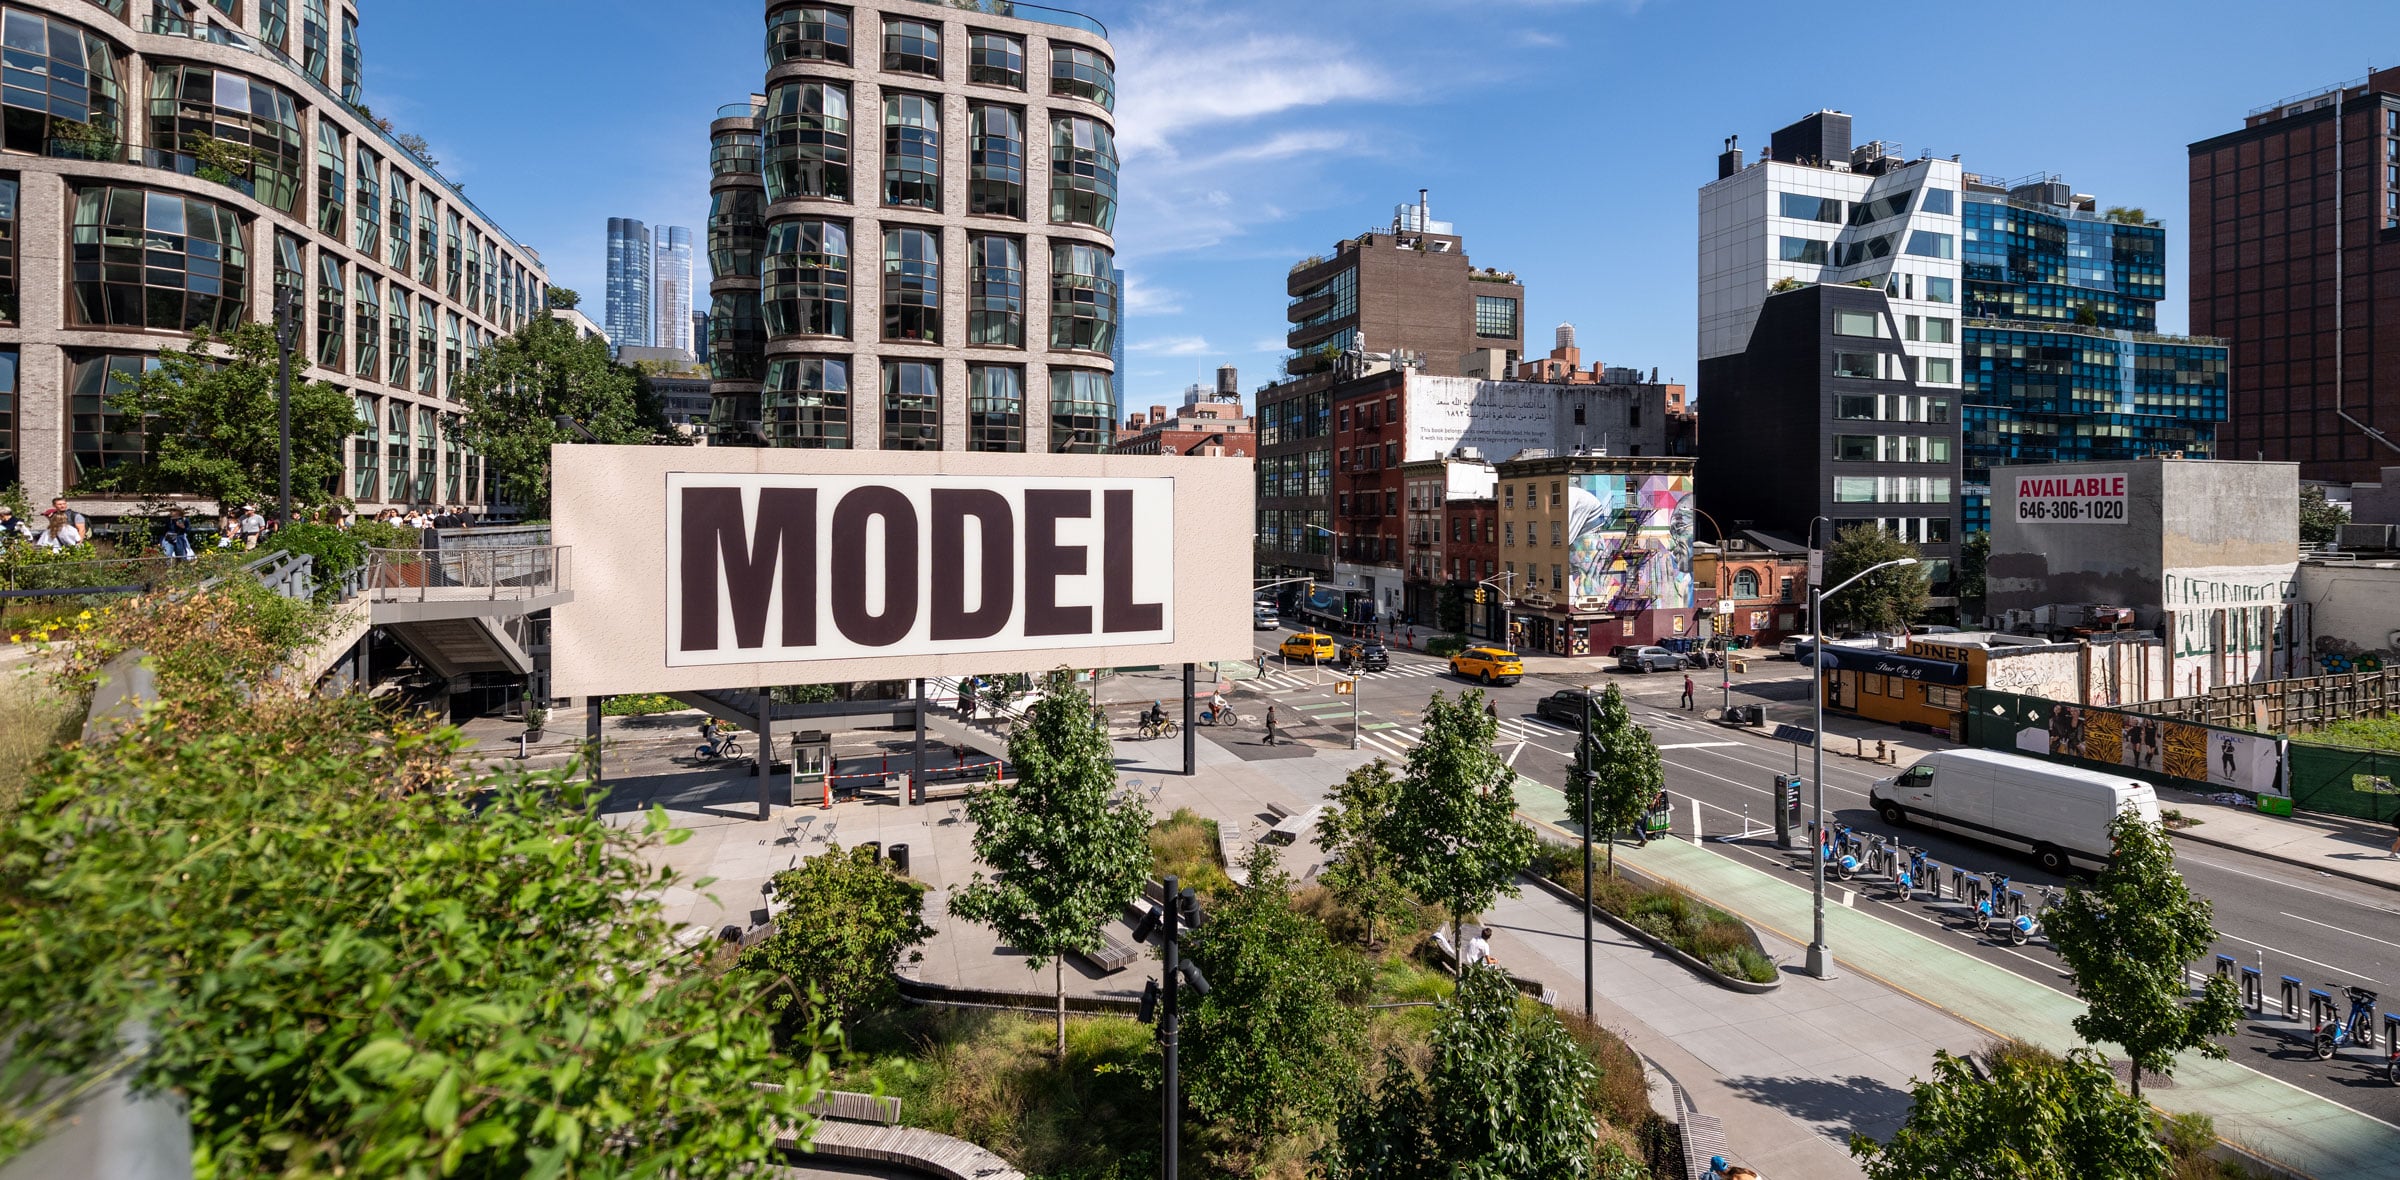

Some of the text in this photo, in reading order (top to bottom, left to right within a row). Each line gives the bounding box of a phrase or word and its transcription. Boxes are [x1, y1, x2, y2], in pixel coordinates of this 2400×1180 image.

[1451, 396, 1462, 406] الله
[2019, 477, 2125, 497] AVAILABLE
[2020, 500, 2123, 520] 646-306-1020
[680, 485, 1163, 652] MODEL
[1913, 644, 1969, 662] DINER
[1875, 661, 1896, 672] Star
[1896, 664, 1910, 675] On
[1911, 668, 1922, 676] 18
[2094, 733, 2114, 741] DKNY
[2173, 746, 2195, 755] DKNY
